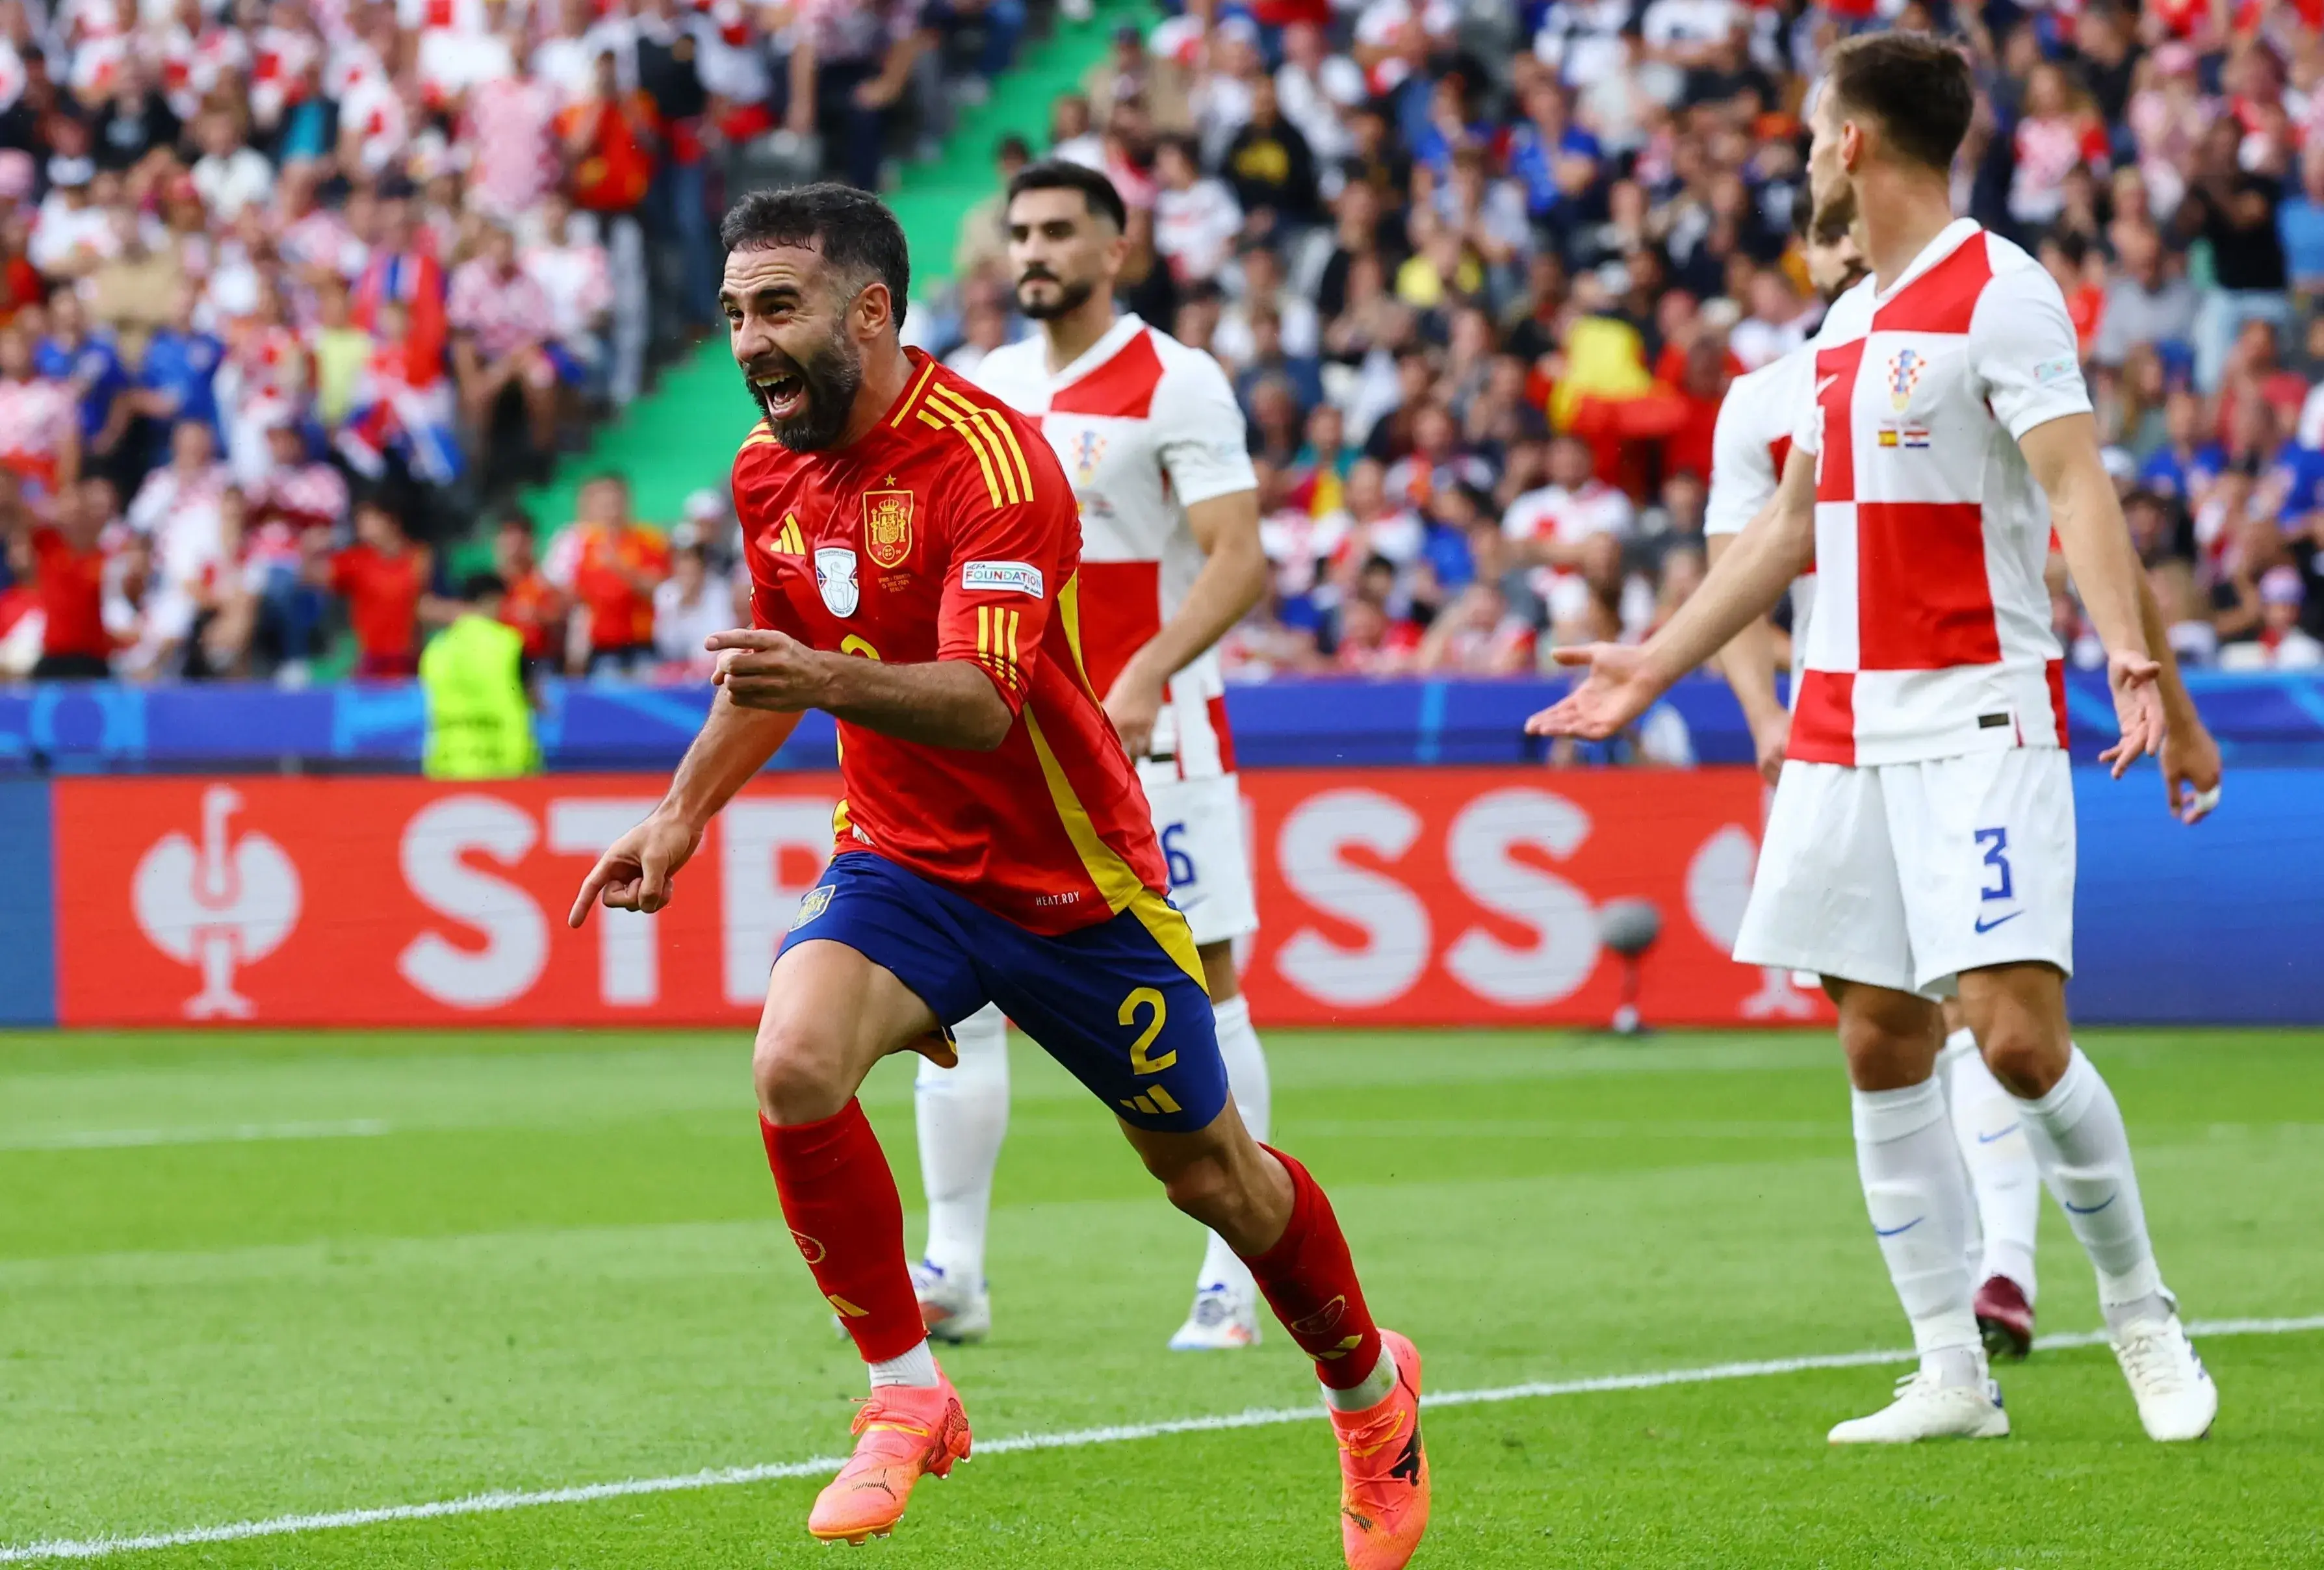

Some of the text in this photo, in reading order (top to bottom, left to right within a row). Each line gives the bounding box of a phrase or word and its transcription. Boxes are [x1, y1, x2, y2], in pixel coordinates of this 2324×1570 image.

[966, 571, 1041, 588] FOUNDATION
[1162, 823, 1196, 886] 6
[1975, 827, 2012, 901] 3
[398, 787, 1600, 1010] STRSS
[1036, 891, 1079, 907] HEAT.RDY
[1117, 986, 1178, 1076] 2
